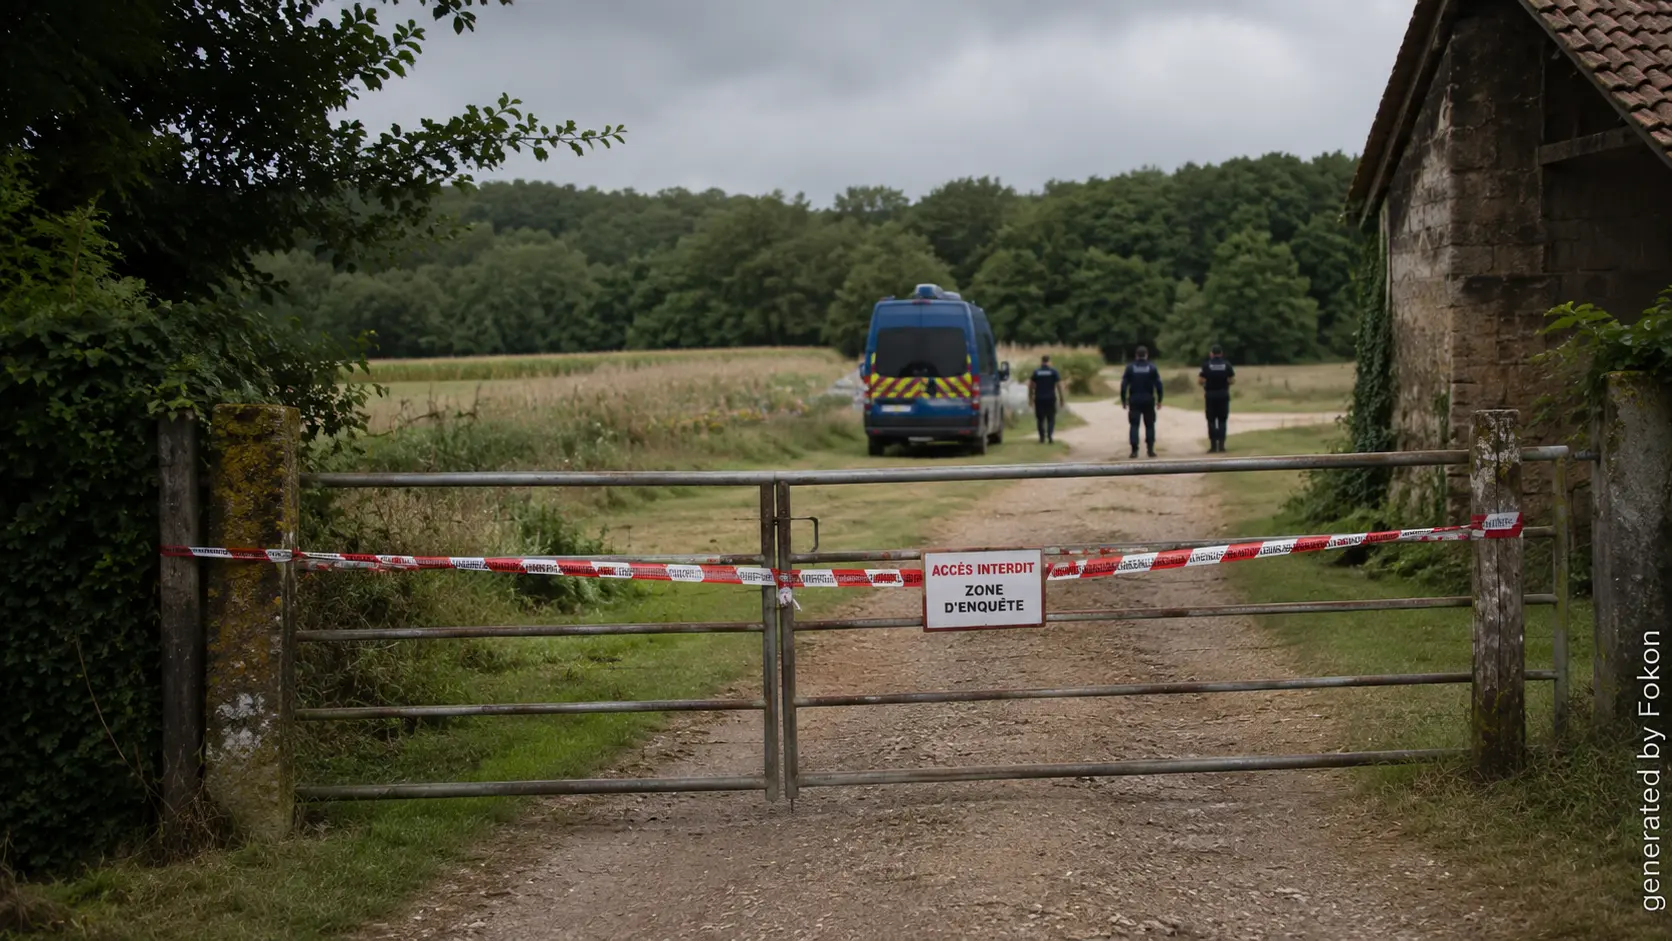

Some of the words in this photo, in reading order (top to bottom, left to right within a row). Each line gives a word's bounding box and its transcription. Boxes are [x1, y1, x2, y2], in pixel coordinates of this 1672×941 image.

[977, 562, 1035, 575] INTERDIT
[965, 584, 1004, 596] ZONE
[944, 598, 1024, 613] D'ENQUÊTE
